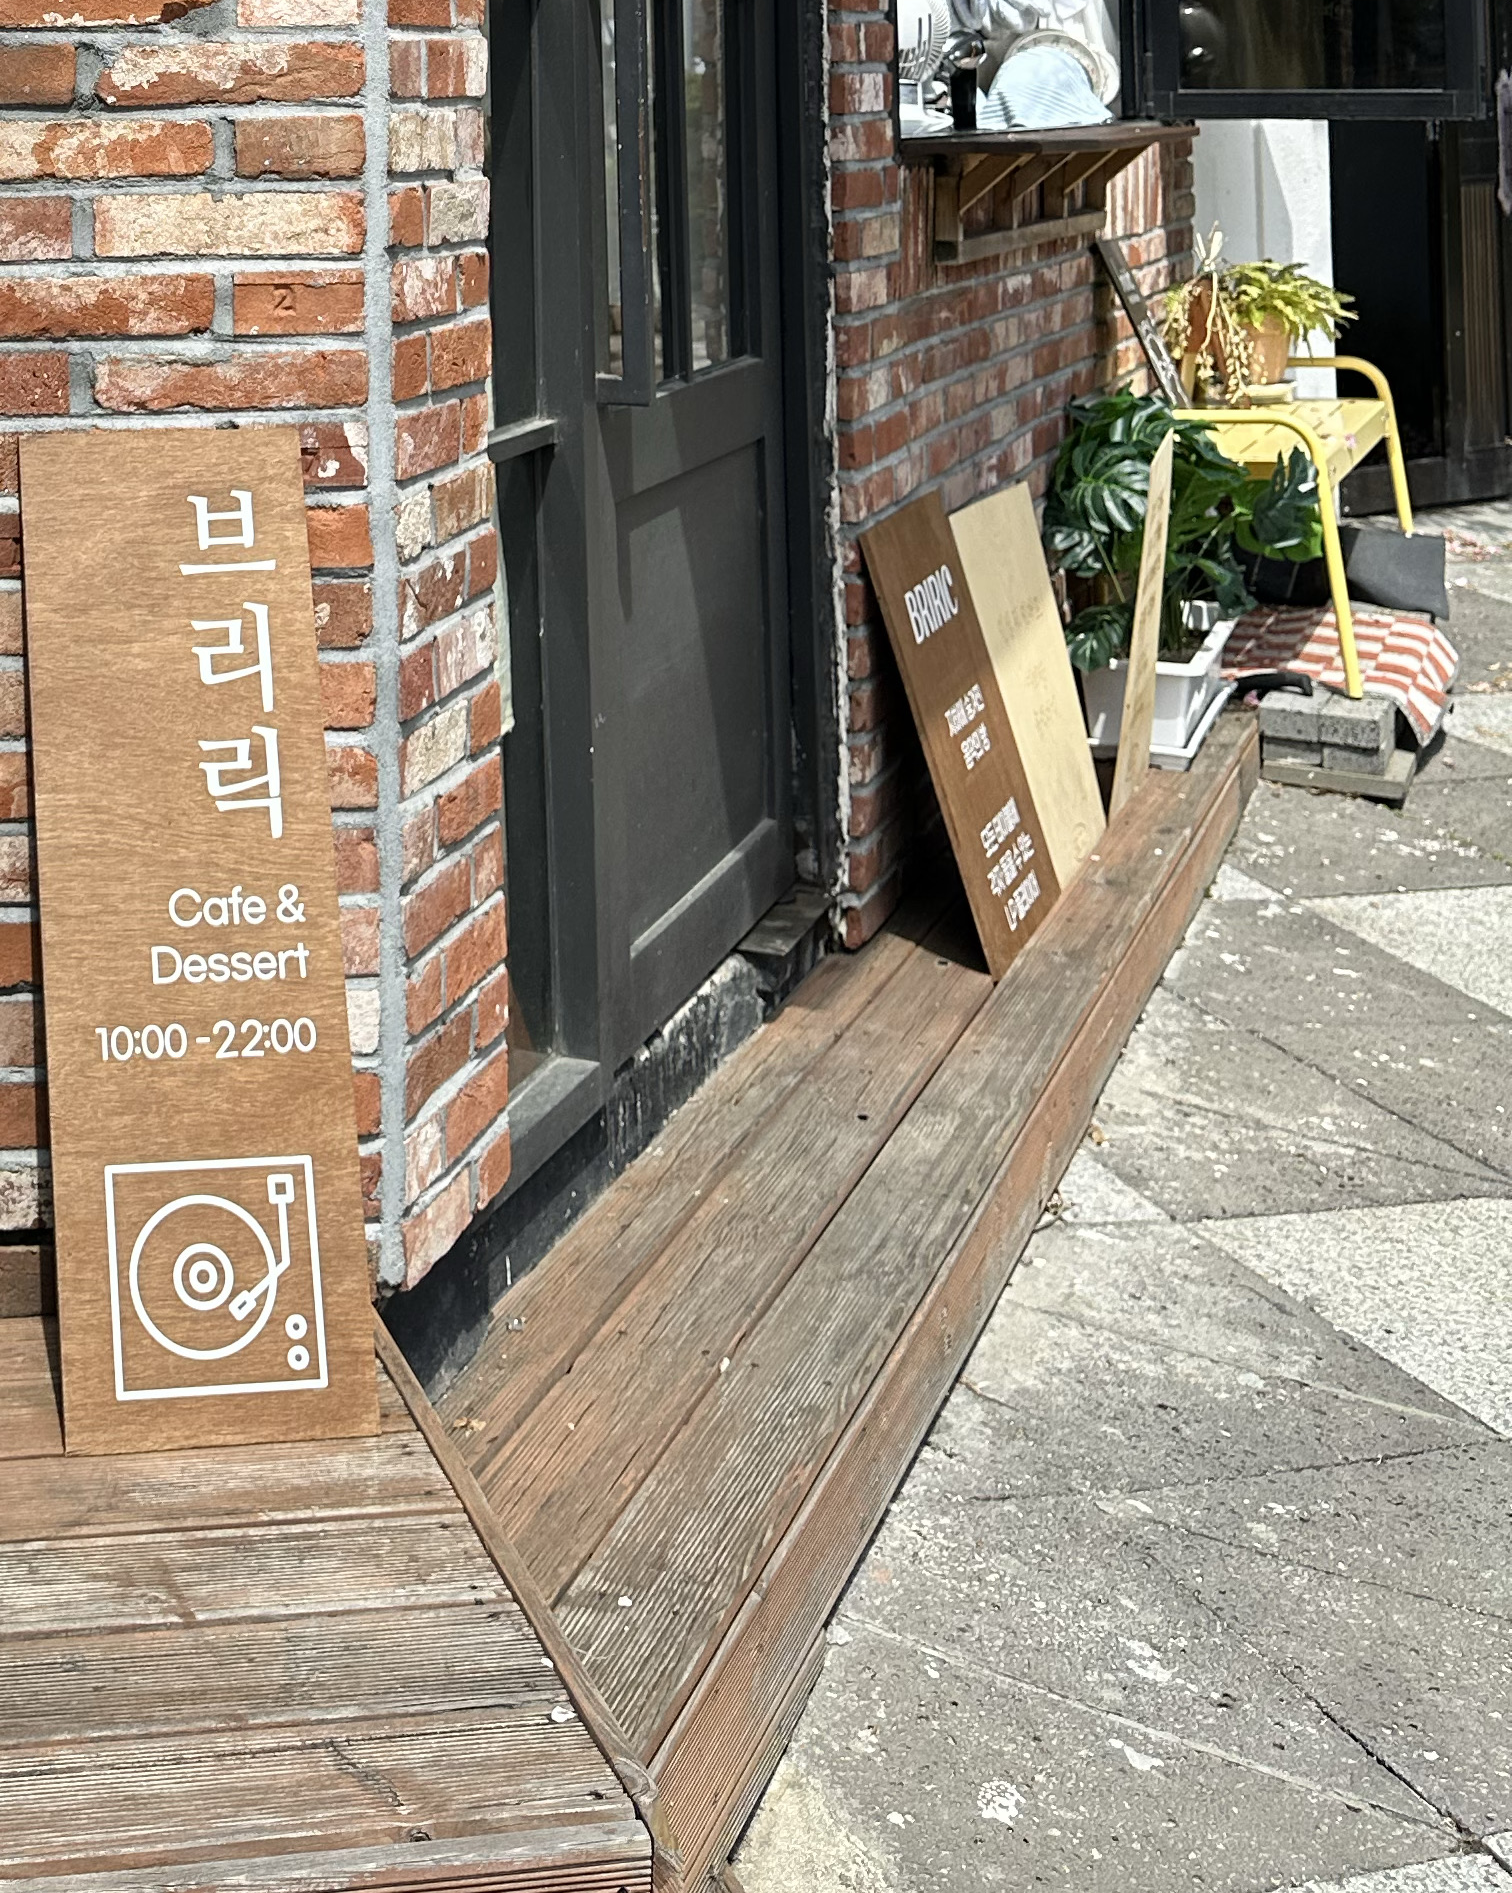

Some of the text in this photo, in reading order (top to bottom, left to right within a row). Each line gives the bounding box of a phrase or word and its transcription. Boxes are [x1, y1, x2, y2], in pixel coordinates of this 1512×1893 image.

[904, 564, 959, 645] BRIRIC
[178, 489, 283, 839] 브리릭
[168, 883, 307, 928] Cafe &
[150, 942, 310, 985] Dessert
